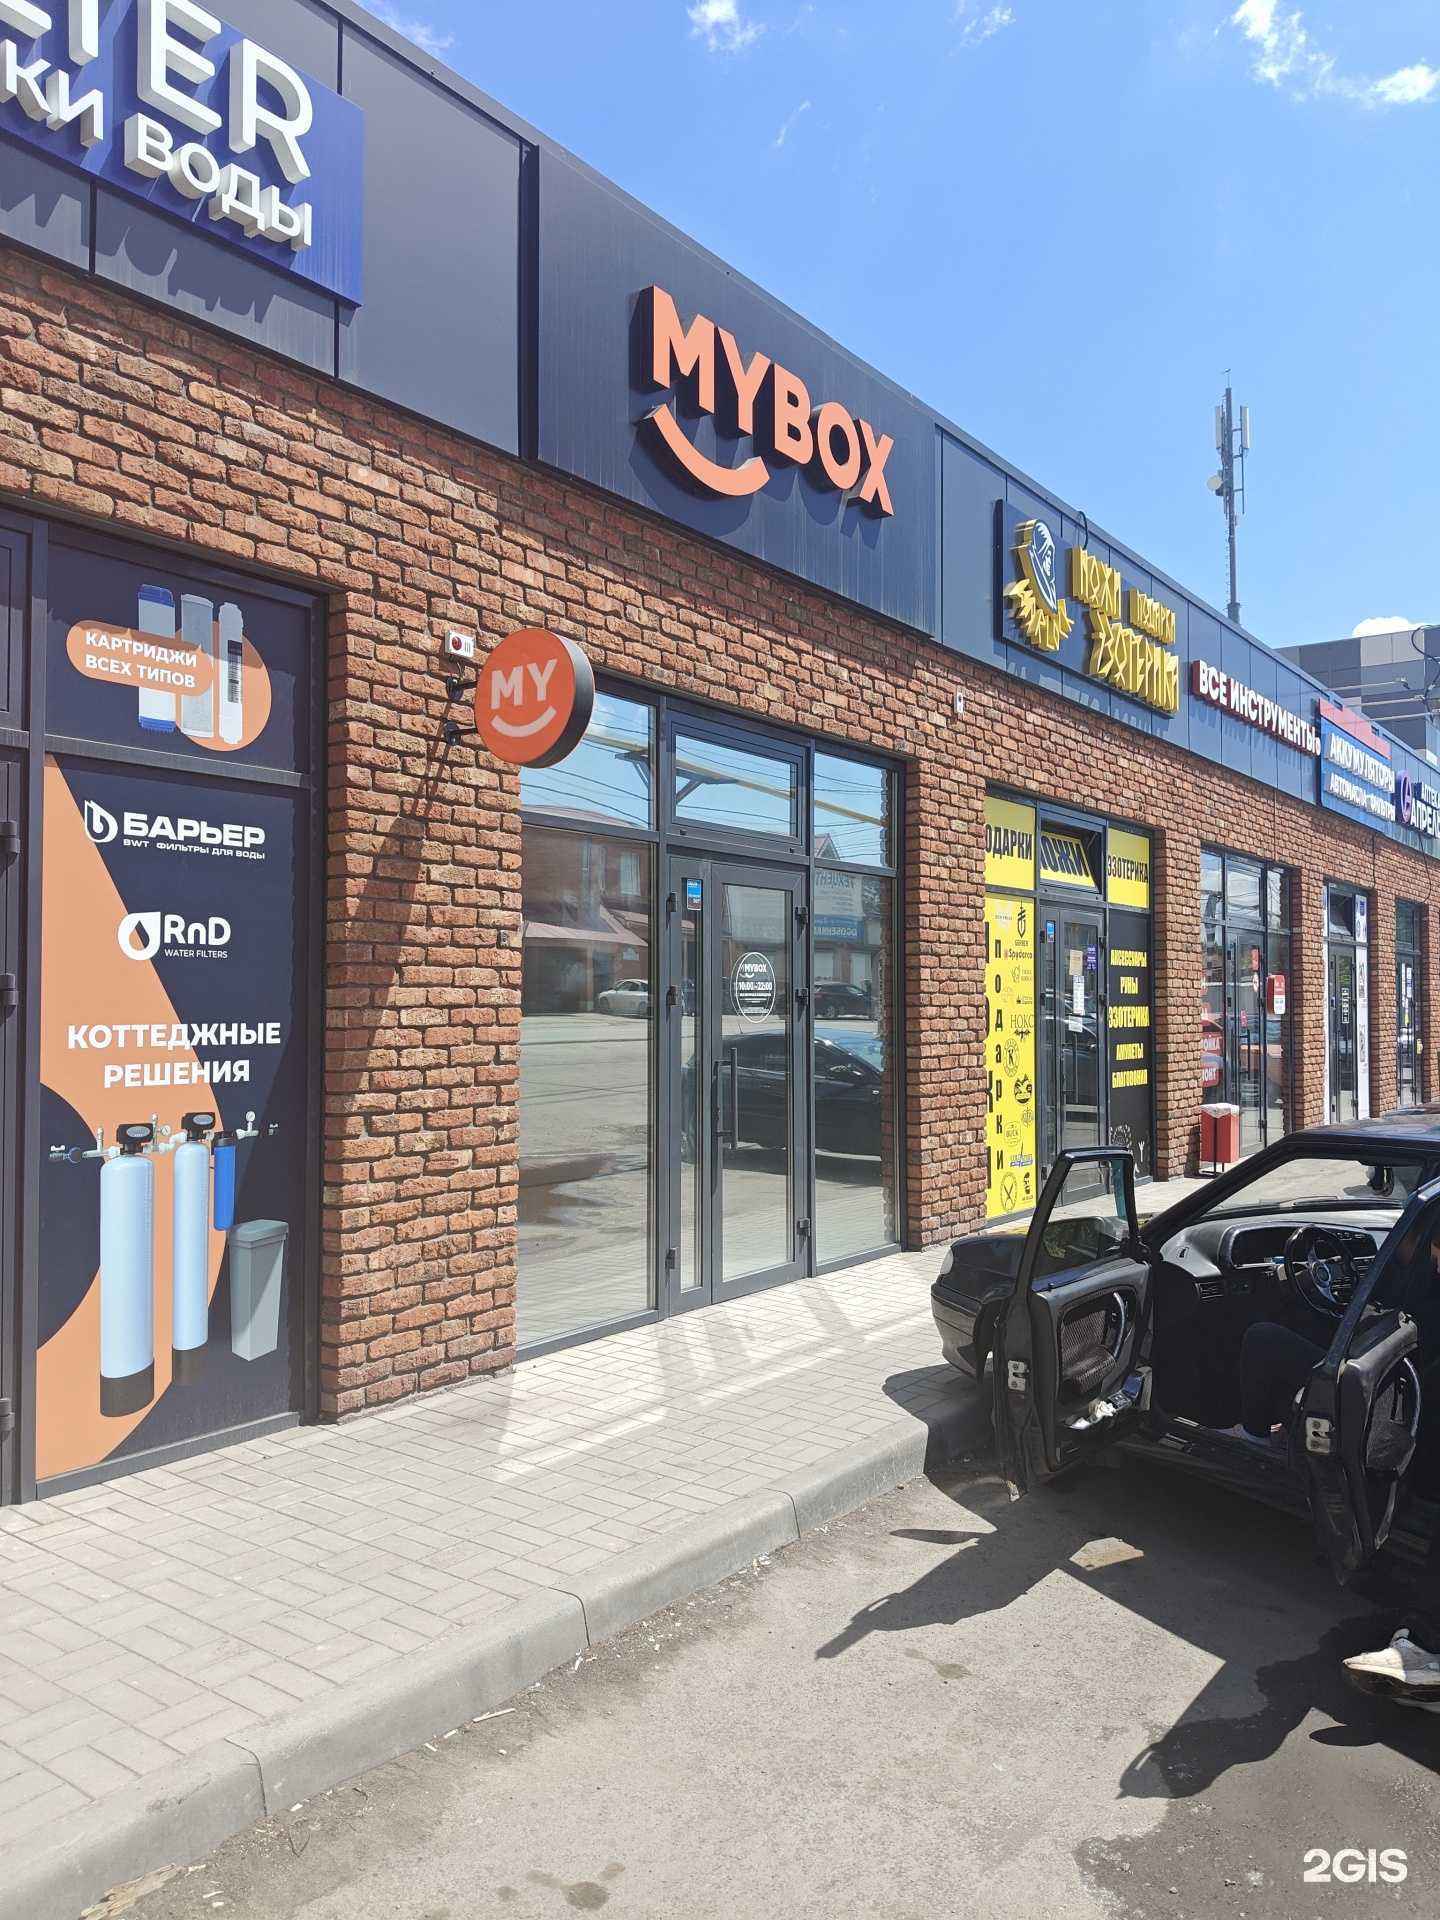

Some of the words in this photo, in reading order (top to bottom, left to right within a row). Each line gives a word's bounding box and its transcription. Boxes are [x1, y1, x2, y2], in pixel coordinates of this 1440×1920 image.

[126, 113, 312, 250] ВОДЫ
[652, 284, 895, 516] MYBOX
[85, 631, 198, 667] КАРТРИДЖИ
[85, 654, 132, 676] ВСЕХ
[137, 664, 197, 688] ТИПОВ
[490, 659, 558, 710] MY
[1199, 660, 1228, 705] ВСЕ
[123, 812, 266, 848] БАРЬЕР
[986, 824, 1032, 860] ОДАРКИ
[123, 839, 150, 847] BWT
[156, 842, 209, 854] ФИЛЬТРЫ
[212, 847, 233, 857] ДЛЯ
[235, 850, 265, 860] ВОДЫ
[1040, 836, 1090, 878] ОЖИ
[1107, 855, 1148, 883] ЭЗОТЕРИКА
[164, 914, 231, 945] RnD
[164, 949, 195, 958] WATER
[196, 950, 228, 959] FILTERS
[744, 963, 767, 973] MYBOX
[1108, 1006, 1150, 1028] ЭЗОТЕРИКА
[67, 1022, 281, 1051] КОТТЕДЖНЫЕ
[103, 1059, 250, 1088] РЕШЕНИЯ
